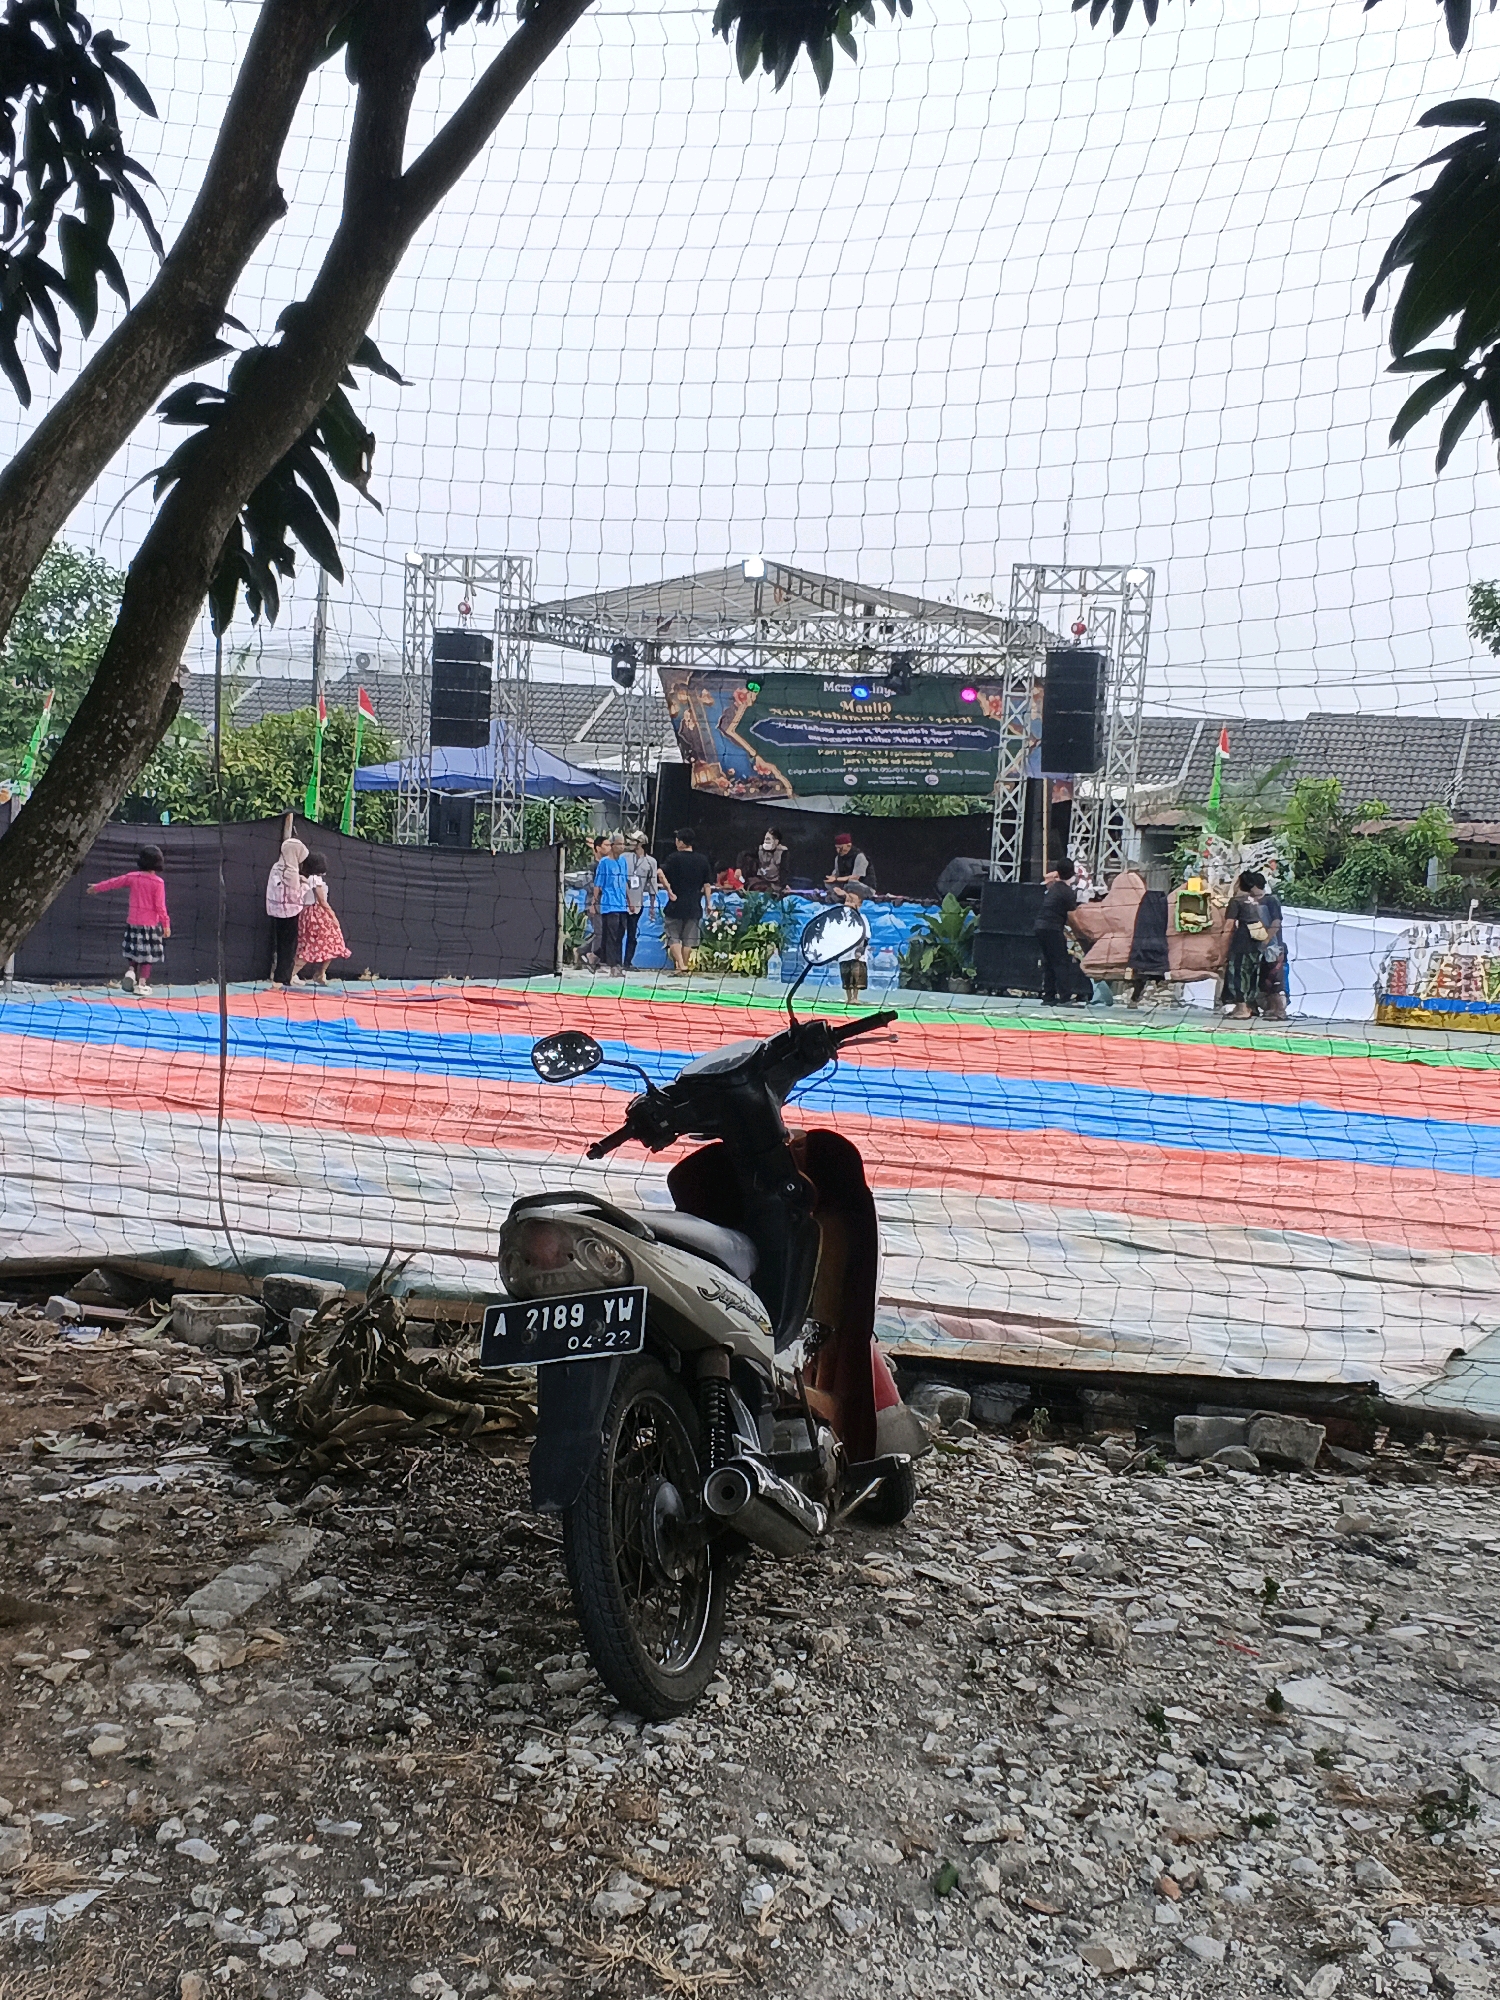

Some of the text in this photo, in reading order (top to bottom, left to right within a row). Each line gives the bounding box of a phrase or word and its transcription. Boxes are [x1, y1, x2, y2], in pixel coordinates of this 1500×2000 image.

[839, 698, 892, 714] Maulid
[492, 1296, 634, 1337] A 2189 YW
